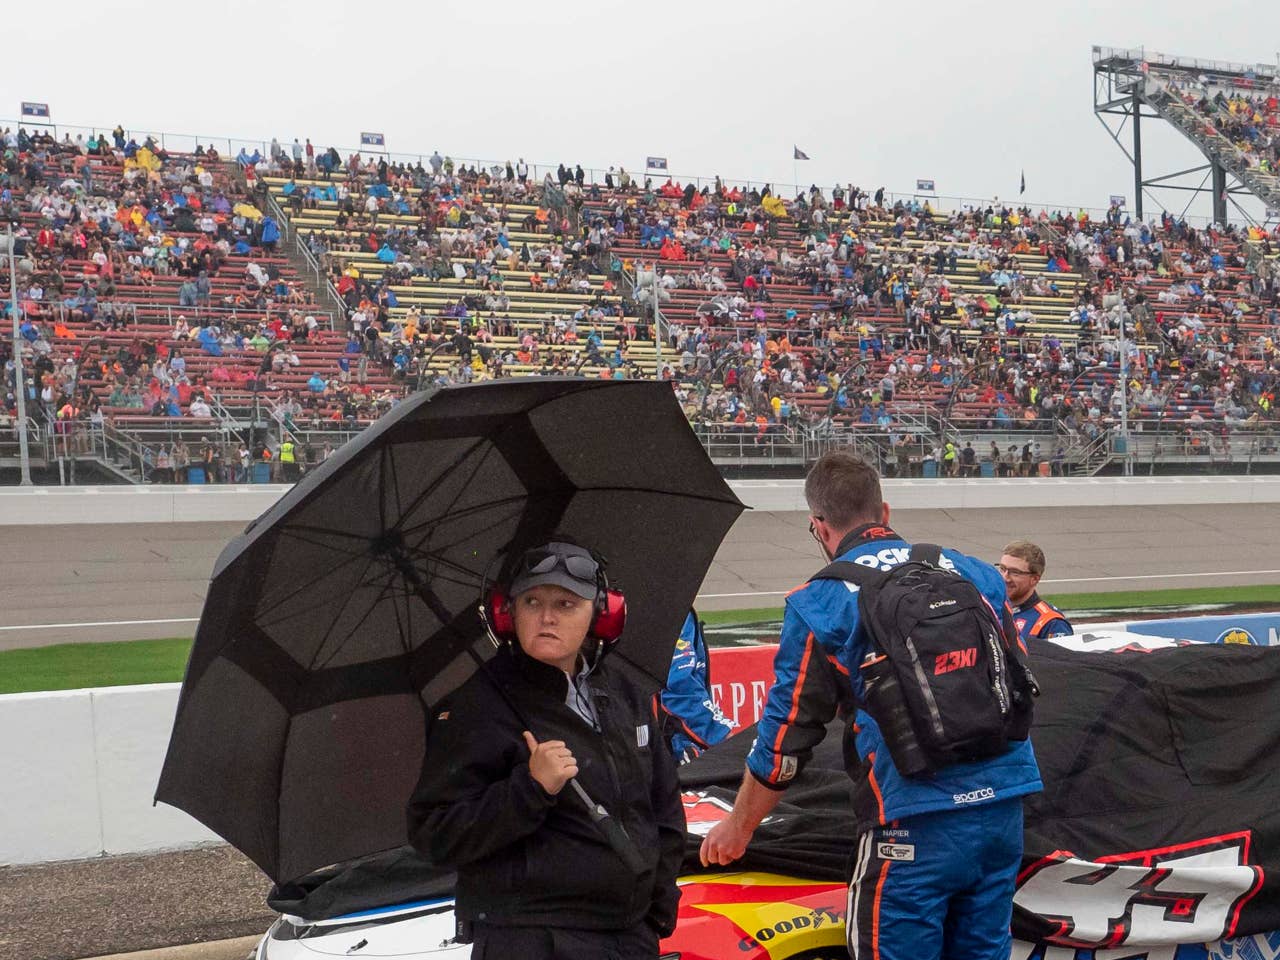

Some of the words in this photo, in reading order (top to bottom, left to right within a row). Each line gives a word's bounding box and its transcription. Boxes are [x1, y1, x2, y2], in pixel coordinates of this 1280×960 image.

[934, 648, 977, 676] 23XI
[953, 787, 994, 803] sparco
[882, 829, 909, 837] NAPIER
